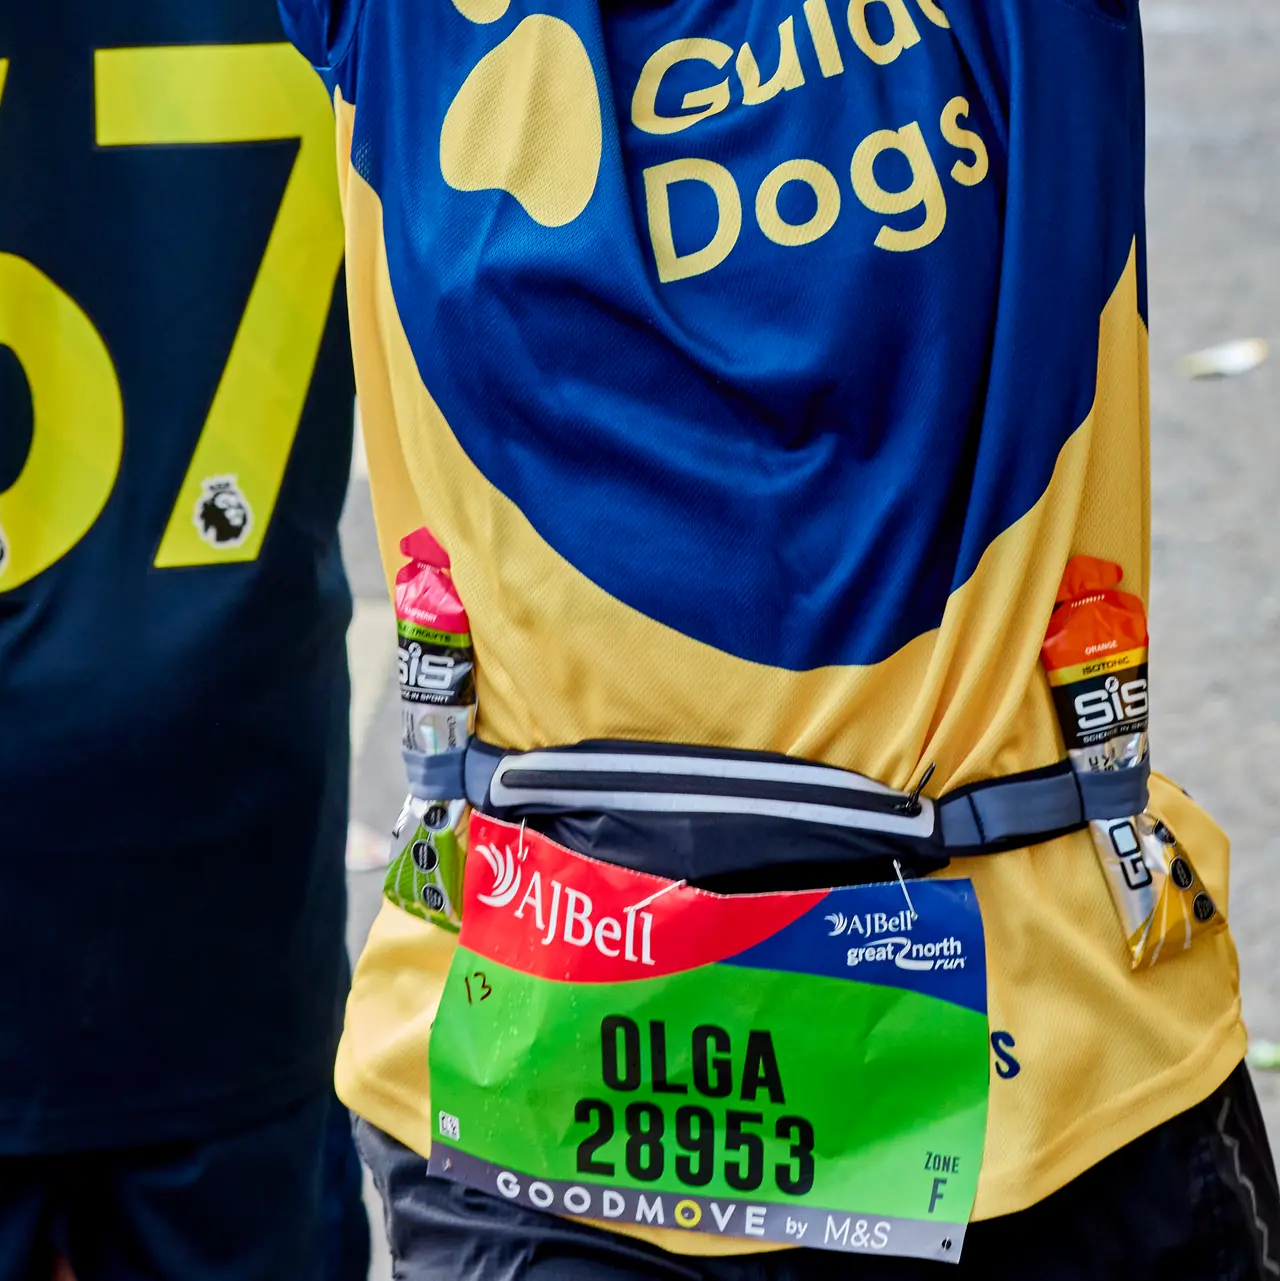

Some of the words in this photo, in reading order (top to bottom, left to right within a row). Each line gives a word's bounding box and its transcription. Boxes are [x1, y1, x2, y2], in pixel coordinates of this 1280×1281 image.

[642, 95, 989, 284] Dogs
[1085, 639, 1118, 656] ORANGE
[1082, 656, 1130, 676] ISOTONIC
[846, 942, 894, 967] great
[912, 936, 962, 958] north
[934, 957, 967, 971] run
[463, 971, 493, 1006] 13
[600, 1013, 787, 1106] OLGA
[574, 1097, 816, 1197] 28953
[923, 1150, 961, 1174] ZONE
[495, 1170, 768, 1236] GOODMOVE
[785, 1216, 809, 1239] by
[822, 1214, 892, 1250] M&S
[927, 1176, 948, 1214] F
